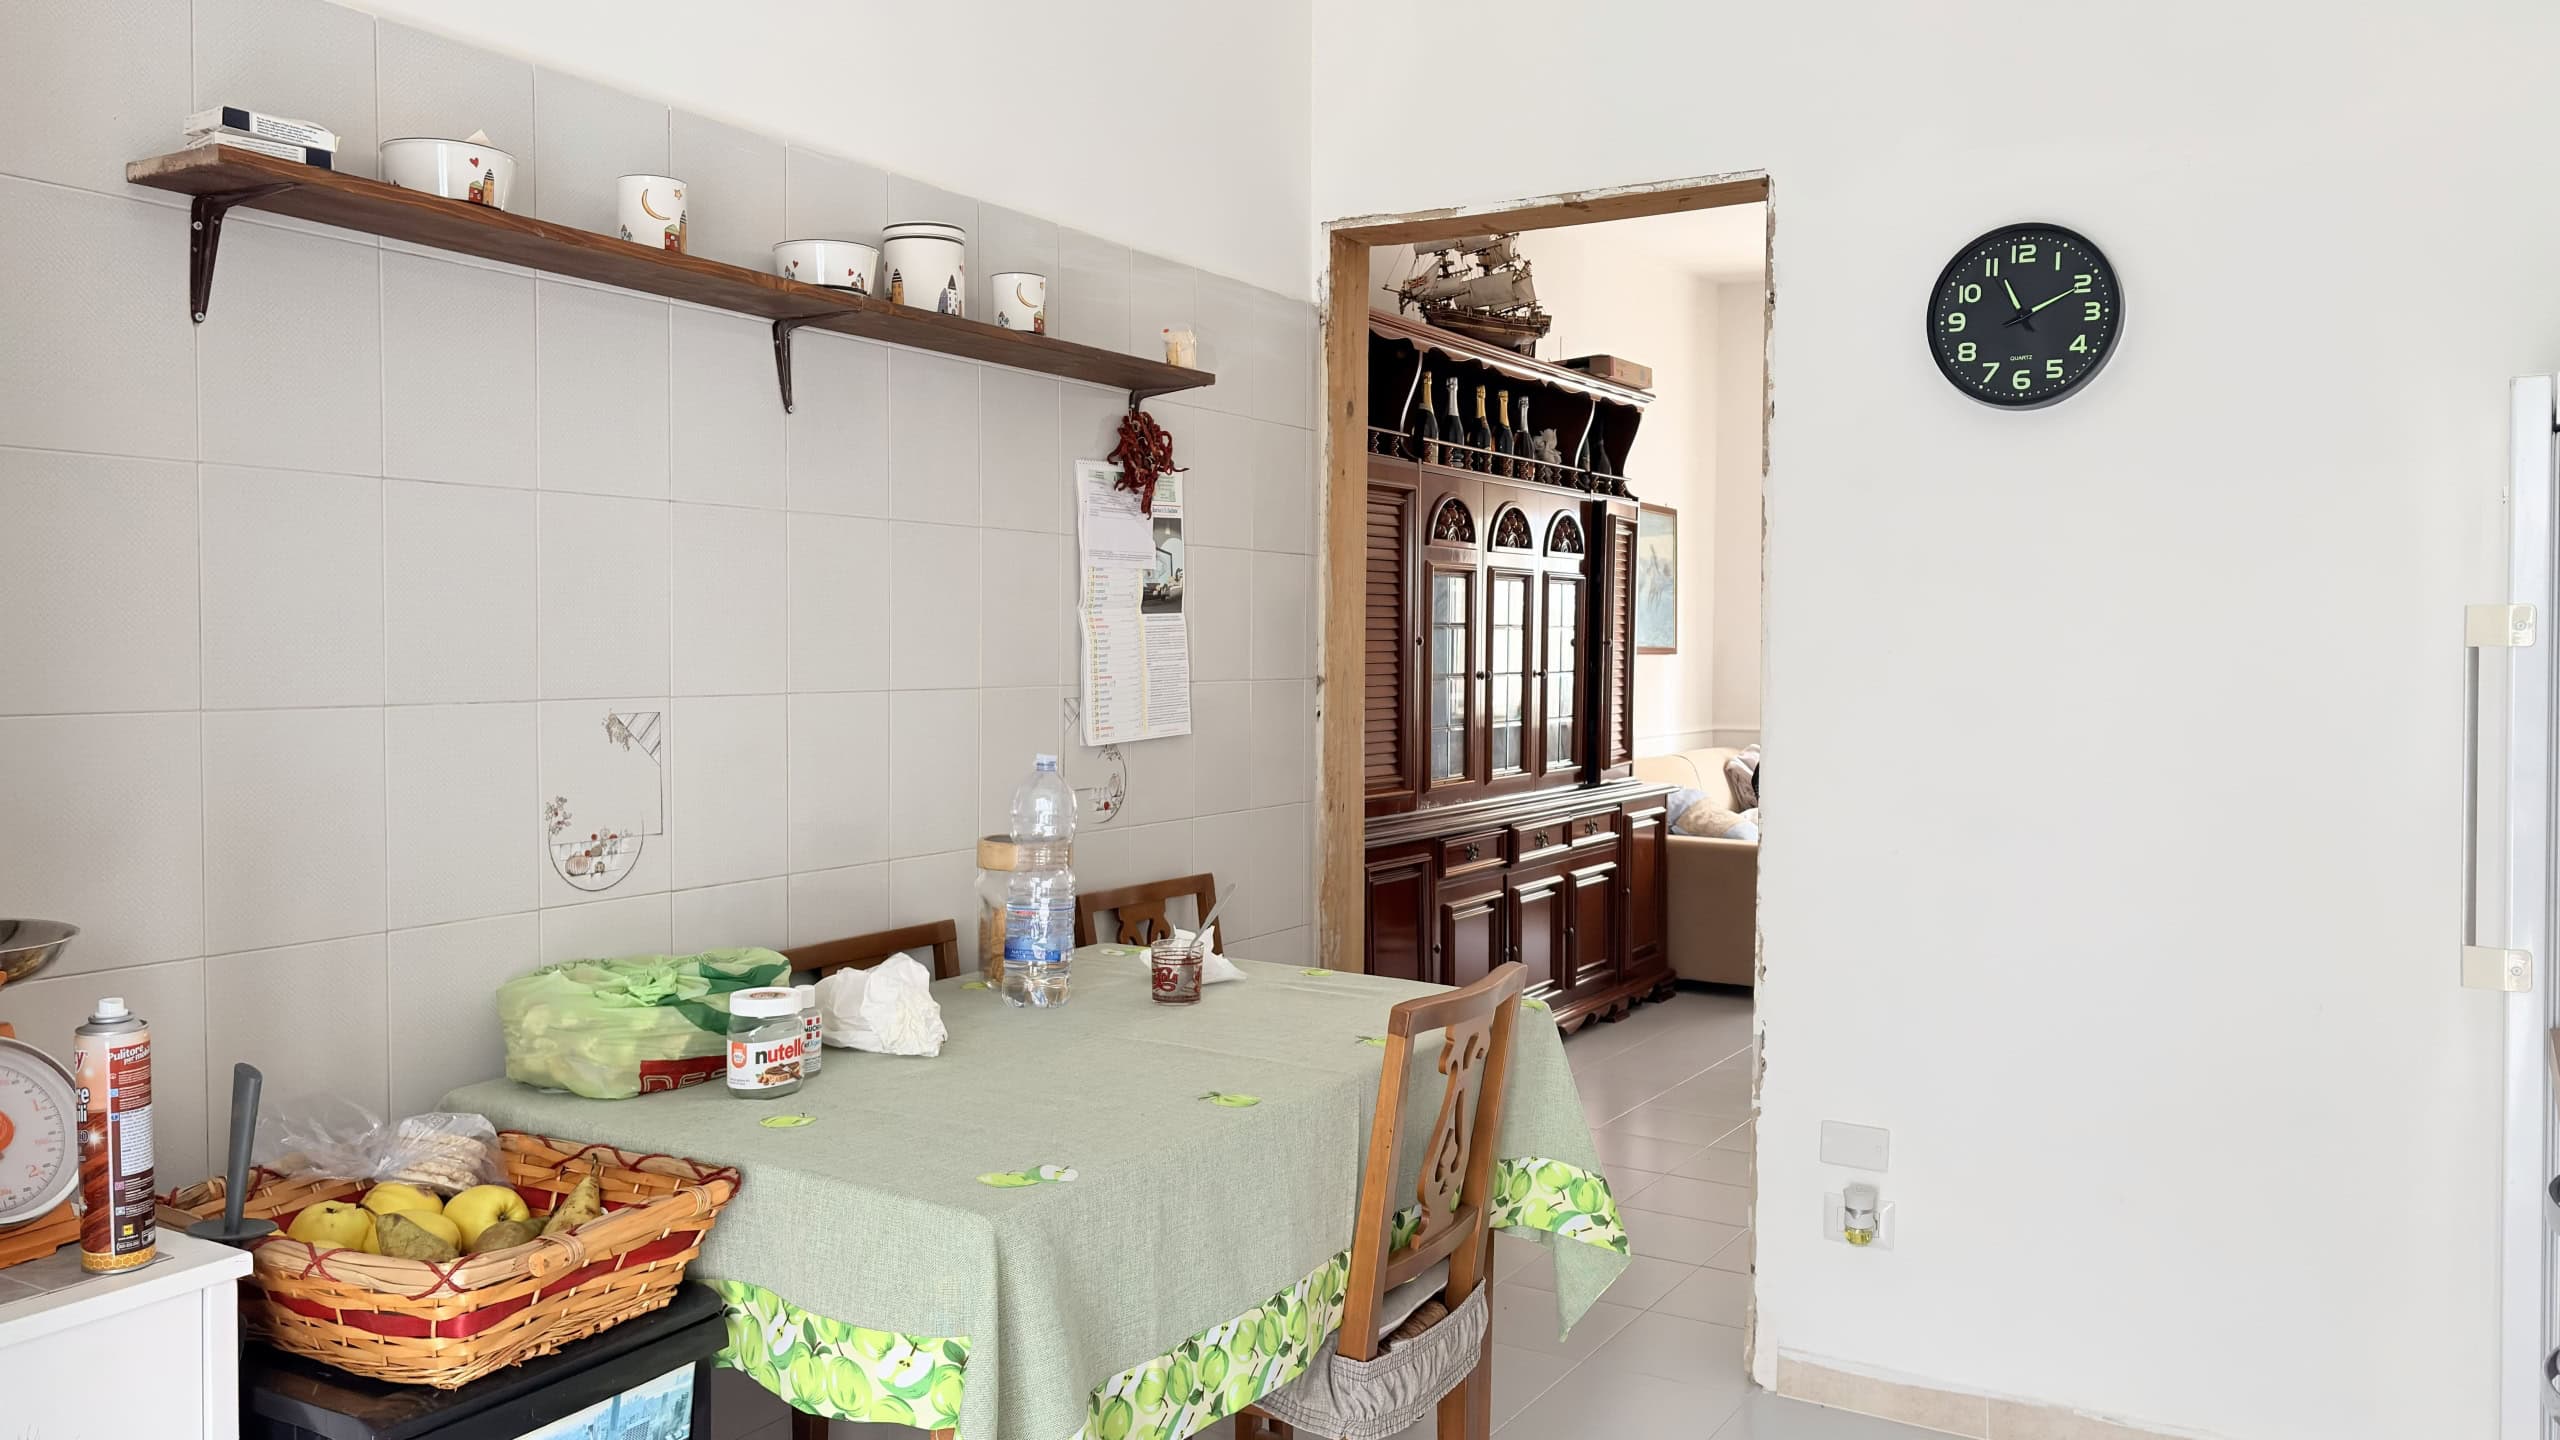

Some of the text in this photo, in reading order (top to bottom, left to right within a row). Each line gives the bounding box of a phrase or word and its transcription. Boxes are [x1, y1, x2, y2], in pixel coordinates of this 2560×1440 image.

[2011, 244, 2037, 264] 12
[2055, 251, 2061, 271] 1
[1985, 257, 1999, 277] 11
[1958, 283, 1982, 304] 10
[2073, 274, 2092, 293] 2
[2084, 301, 2101, 321] 3
[1948, 312, 1966, 332] 9
[1957, 342, 1977, 362] 8
[2069, 334, 2088, 354] 4
[1982, 362, 2000, 383] 7
[2046, 359, 2064, 379] 5
[2012, 369, 2031, 390] 6
[108, 1045, 143, 1061] Pulitore
